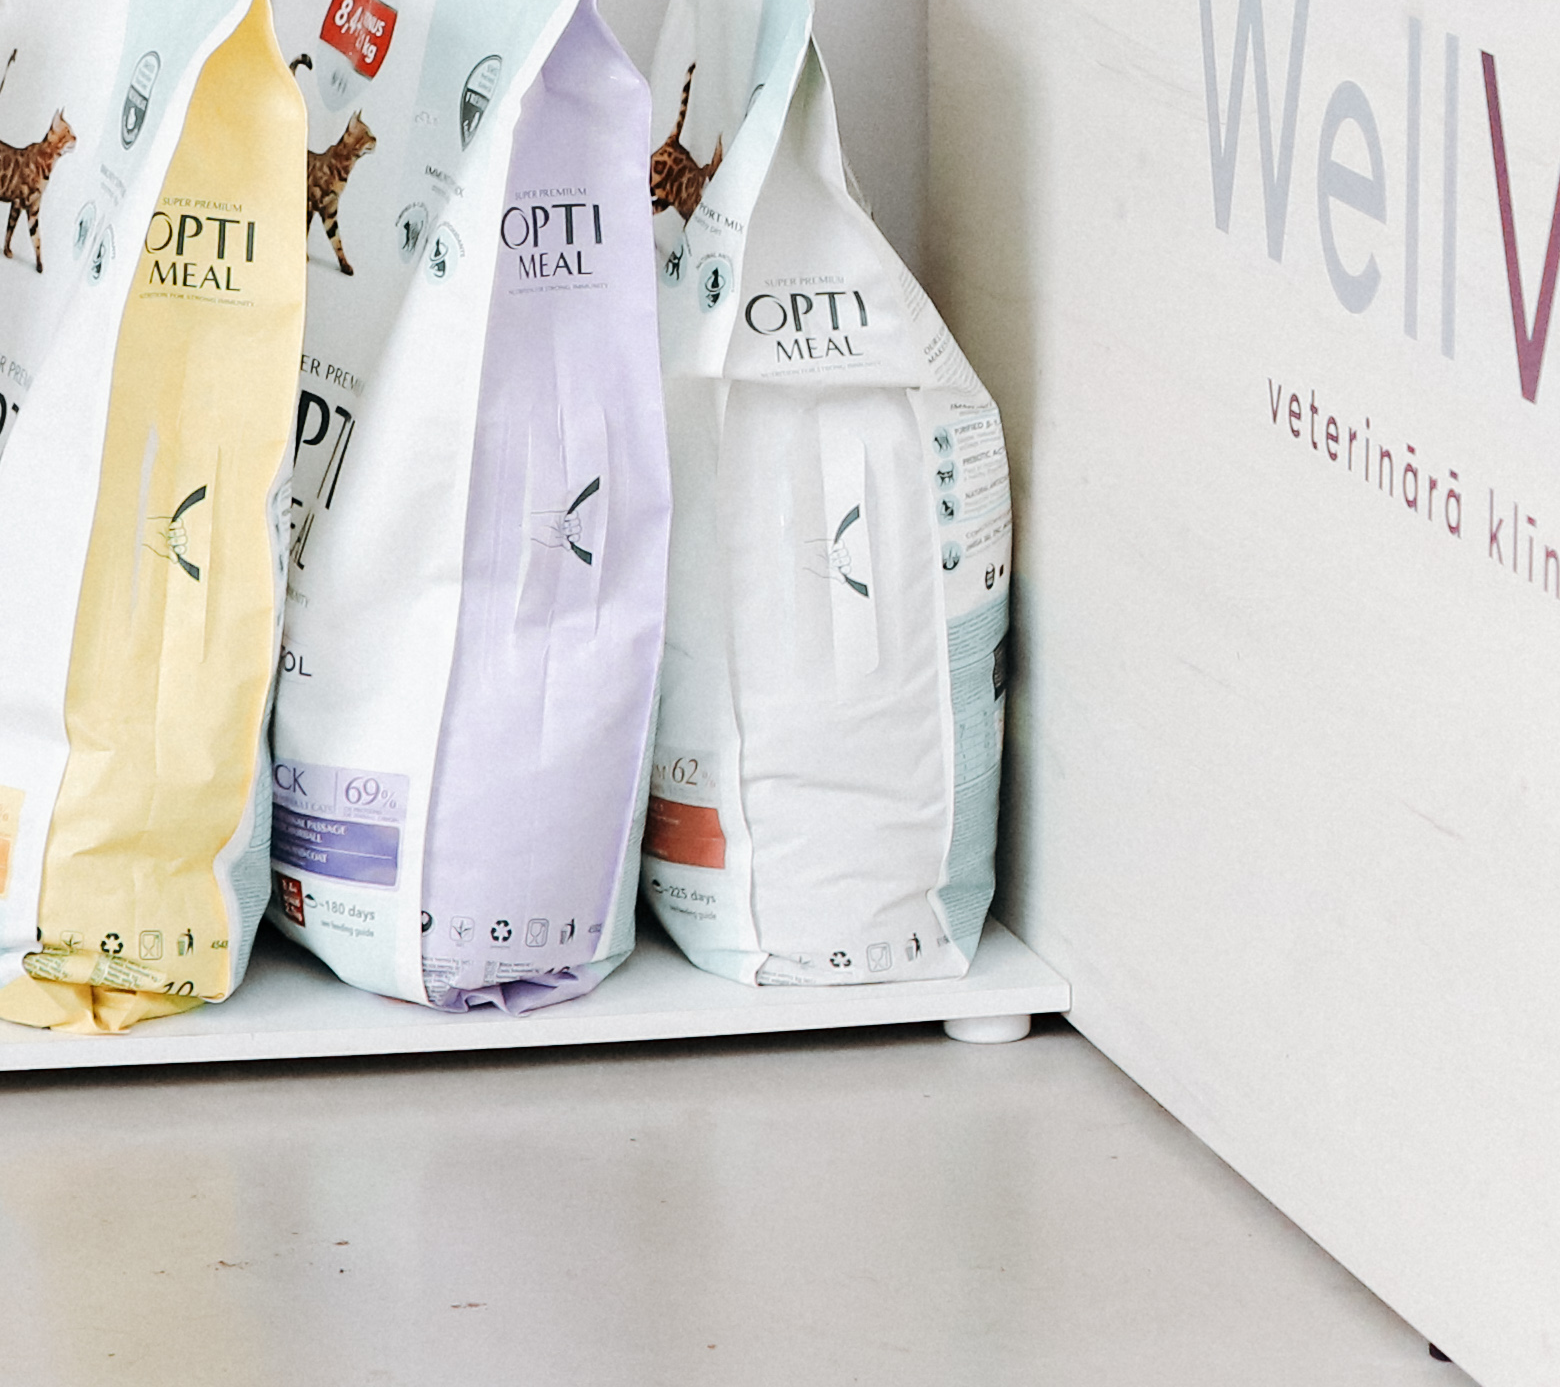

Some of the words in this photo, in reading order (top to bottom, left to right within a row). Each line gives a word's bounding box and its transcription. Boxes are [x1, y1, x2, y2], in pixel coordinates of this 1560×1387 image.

[144, 214, 257, 263] OPTI
[500, 203, 603, 250] OPTI
[149, 259, 241, 292] MEAL
[518, 250, 593, 279] MEAL
[744, 289, 868, 337] OPTI
[776, 335, 861, 362] MEAL
[295, 390, 356, 509] PTI
[1268, 377, 1462, 539] veterinārā
[346, 904, 375, 922] days
